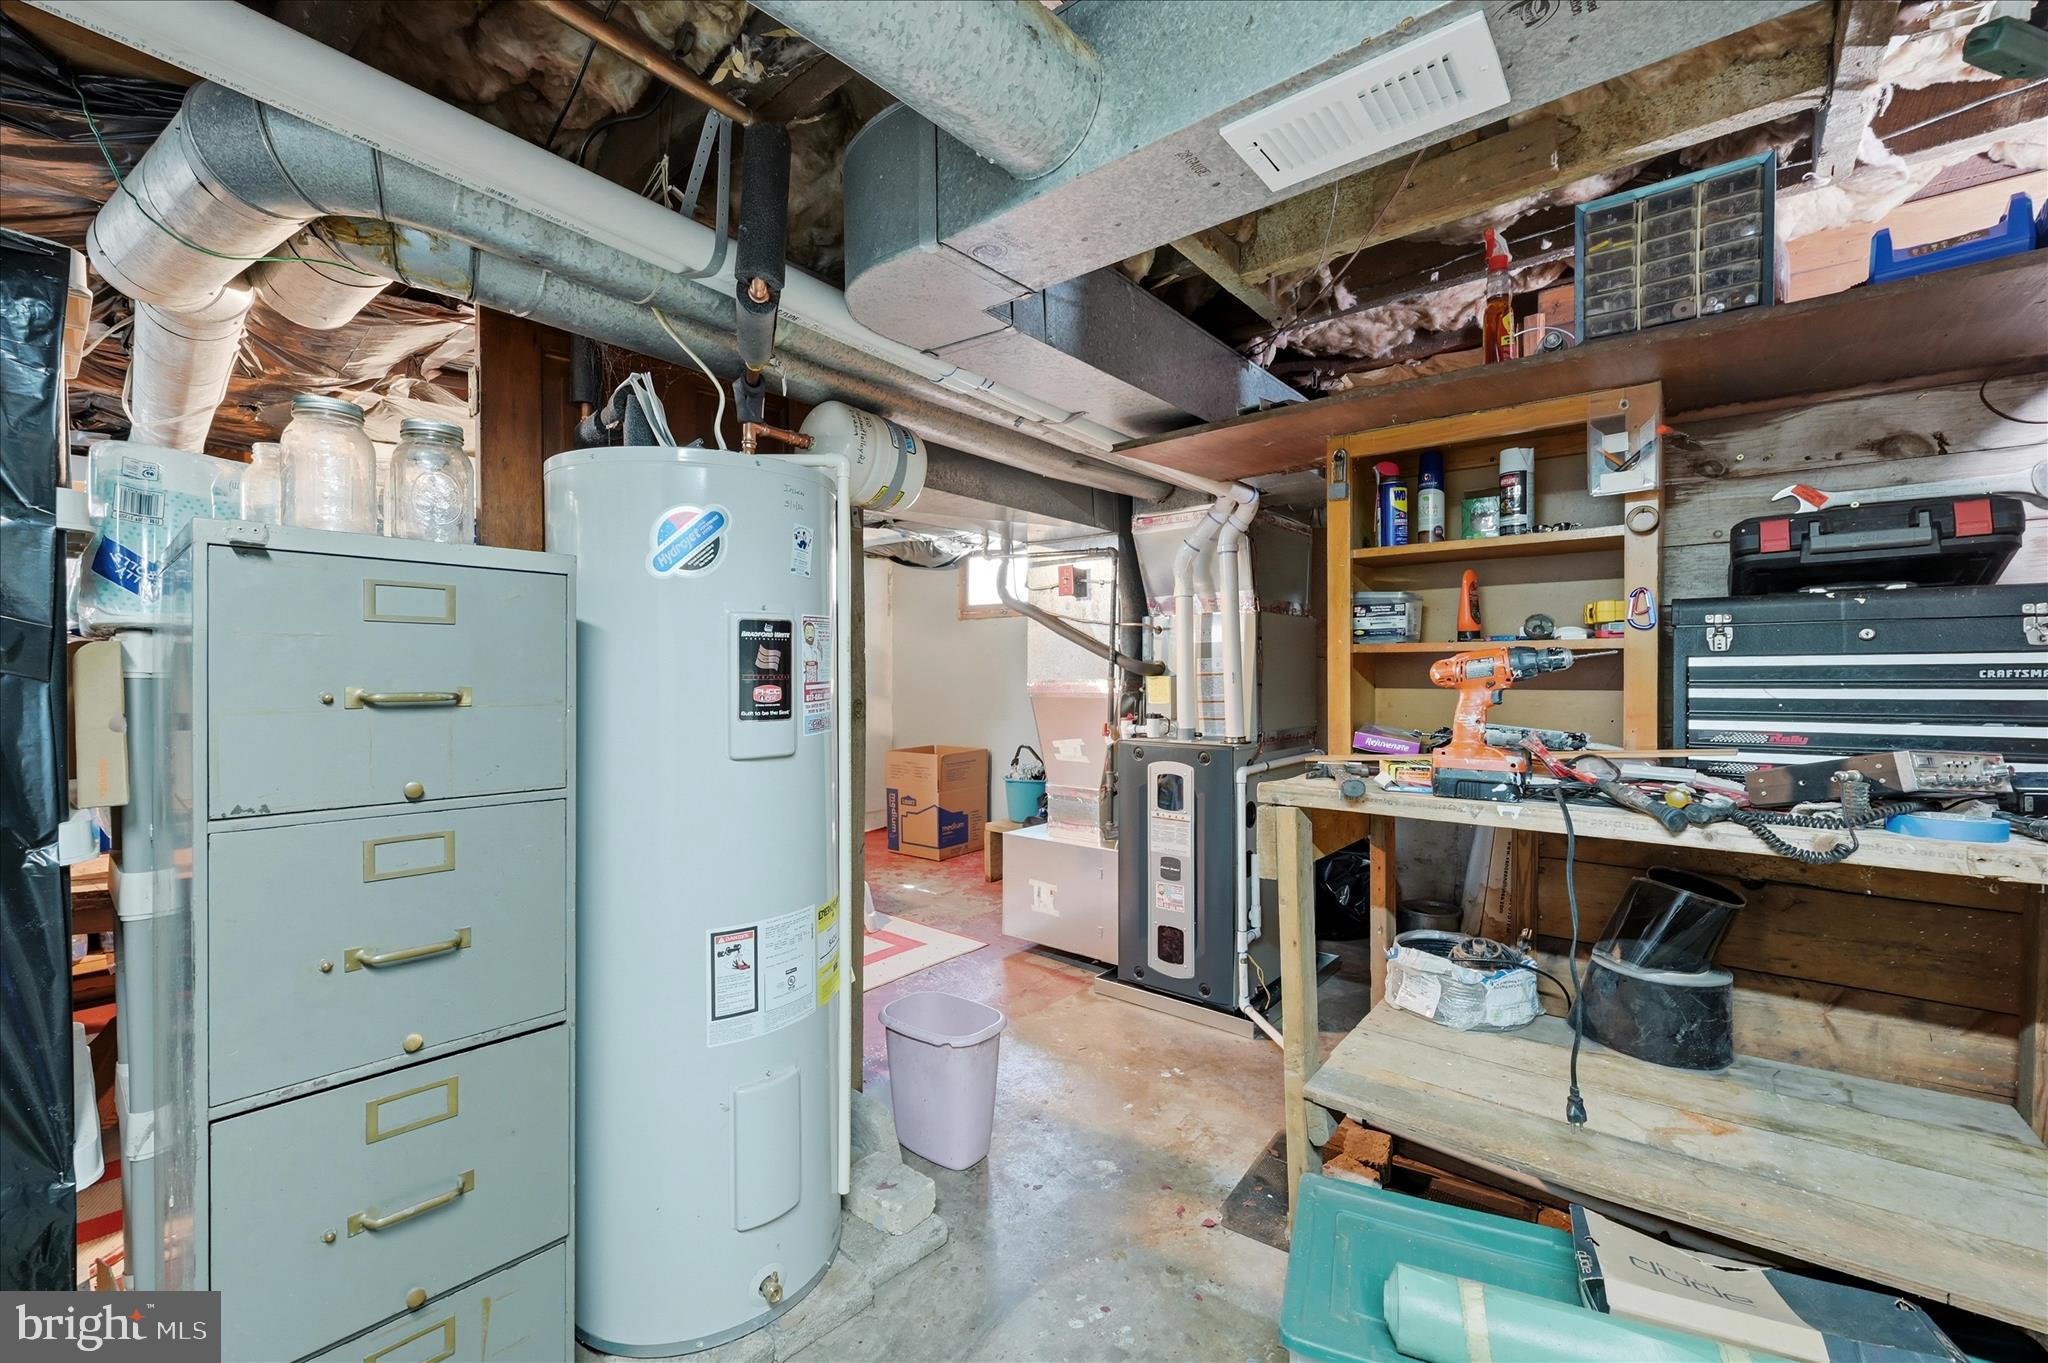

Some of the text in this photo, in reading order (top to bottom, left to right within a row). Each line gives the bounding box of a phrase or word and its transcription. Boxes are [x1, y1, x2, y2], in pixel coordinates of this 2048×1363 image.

[657, 526, 704, 568] Hydrojet
[740, 630, 774, 638] BRADFORD
[1979, 669, 2048, 678] CRAFTSMA
[1365, 738, 1410, 752] Rejuvenate
[1768, 732, 1809, 745] Rally
[888, 793, 897, 833] medium
